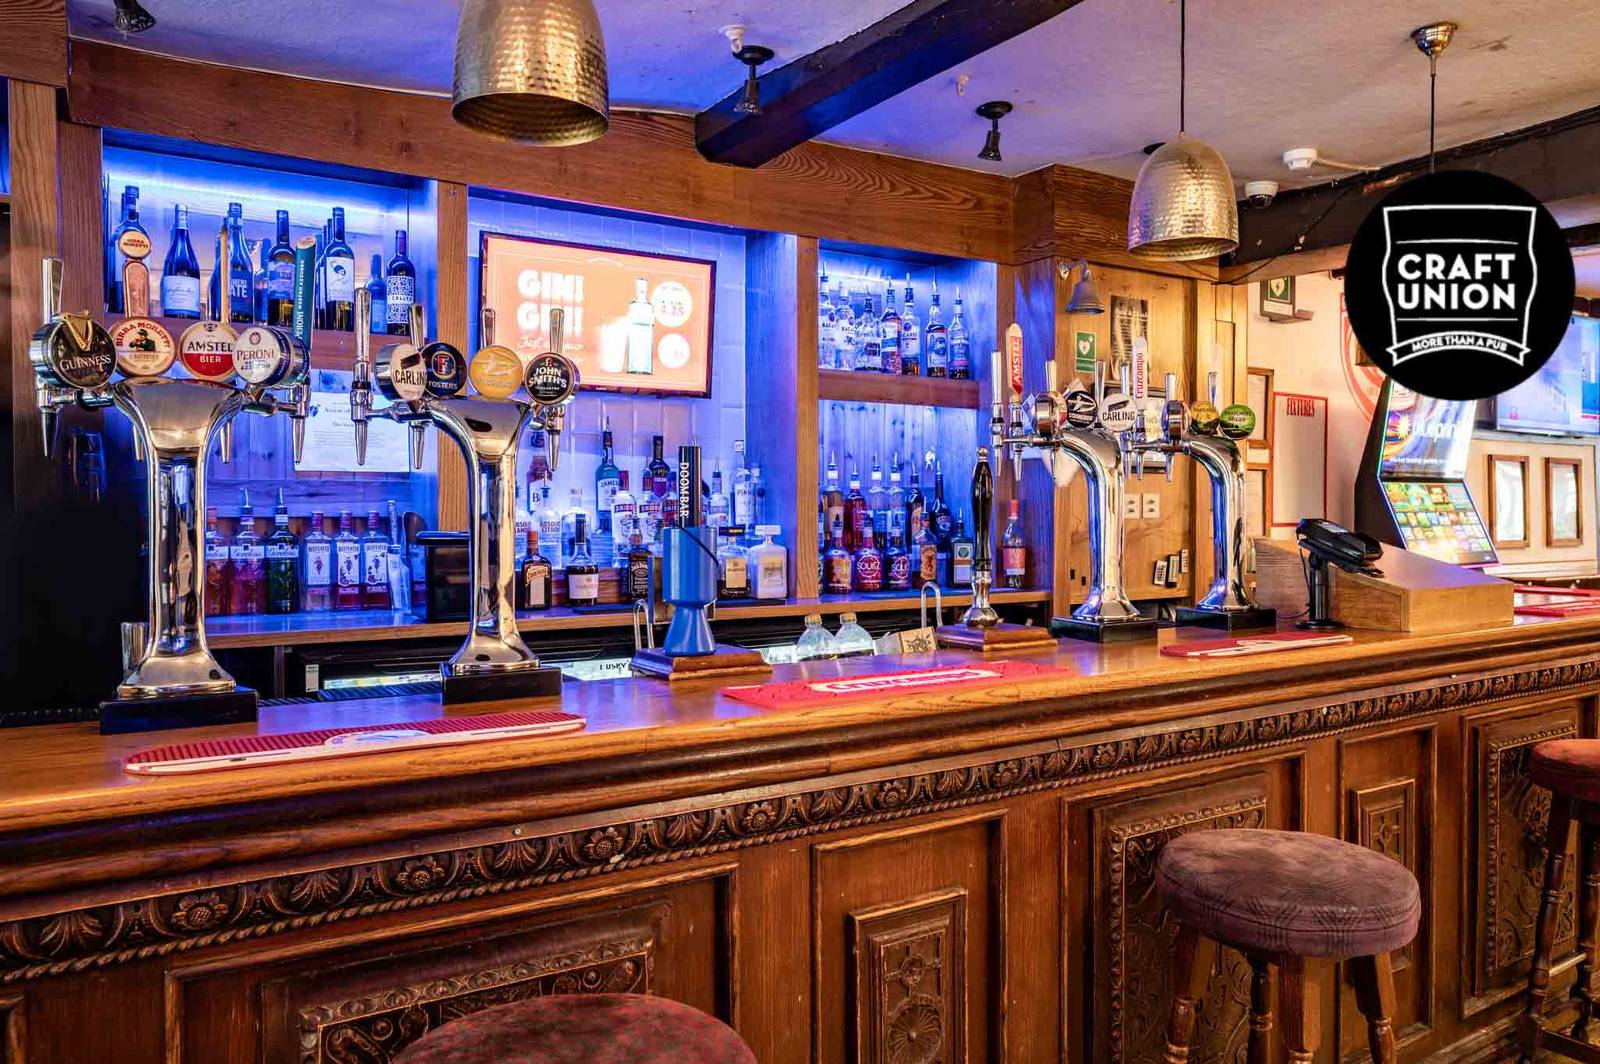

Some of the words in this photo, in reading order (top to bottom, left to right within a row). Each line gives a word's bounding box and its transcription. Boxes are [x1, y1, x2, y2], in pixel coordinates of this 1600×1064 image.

[116, 324, 138, 347] BIRRA
[137, 322, 171, 348] MORETTI
[187, 341, 232, 352] AMSTEL
[236, 349, 276, 361] PERONI
[59, 354, 112, 371] GUINNESS
[200, 355, 222, 363] BIER
[1012, 338, 1021, 383] AMSTEL
[394, 369, 426, 386] CARLIN
[533, 367, 562, 377] JOHN
[1135, 353, 1145, 399] Cruzcampo
[528, 374, 567, 388] SMITH'S
[1286, 397, 1315, 417] FIXTURES
[1102, 412, 1135, 421] CARLING
[680, 462, 690, 494] DOOM
[680, 494, 690, 517] BAR
